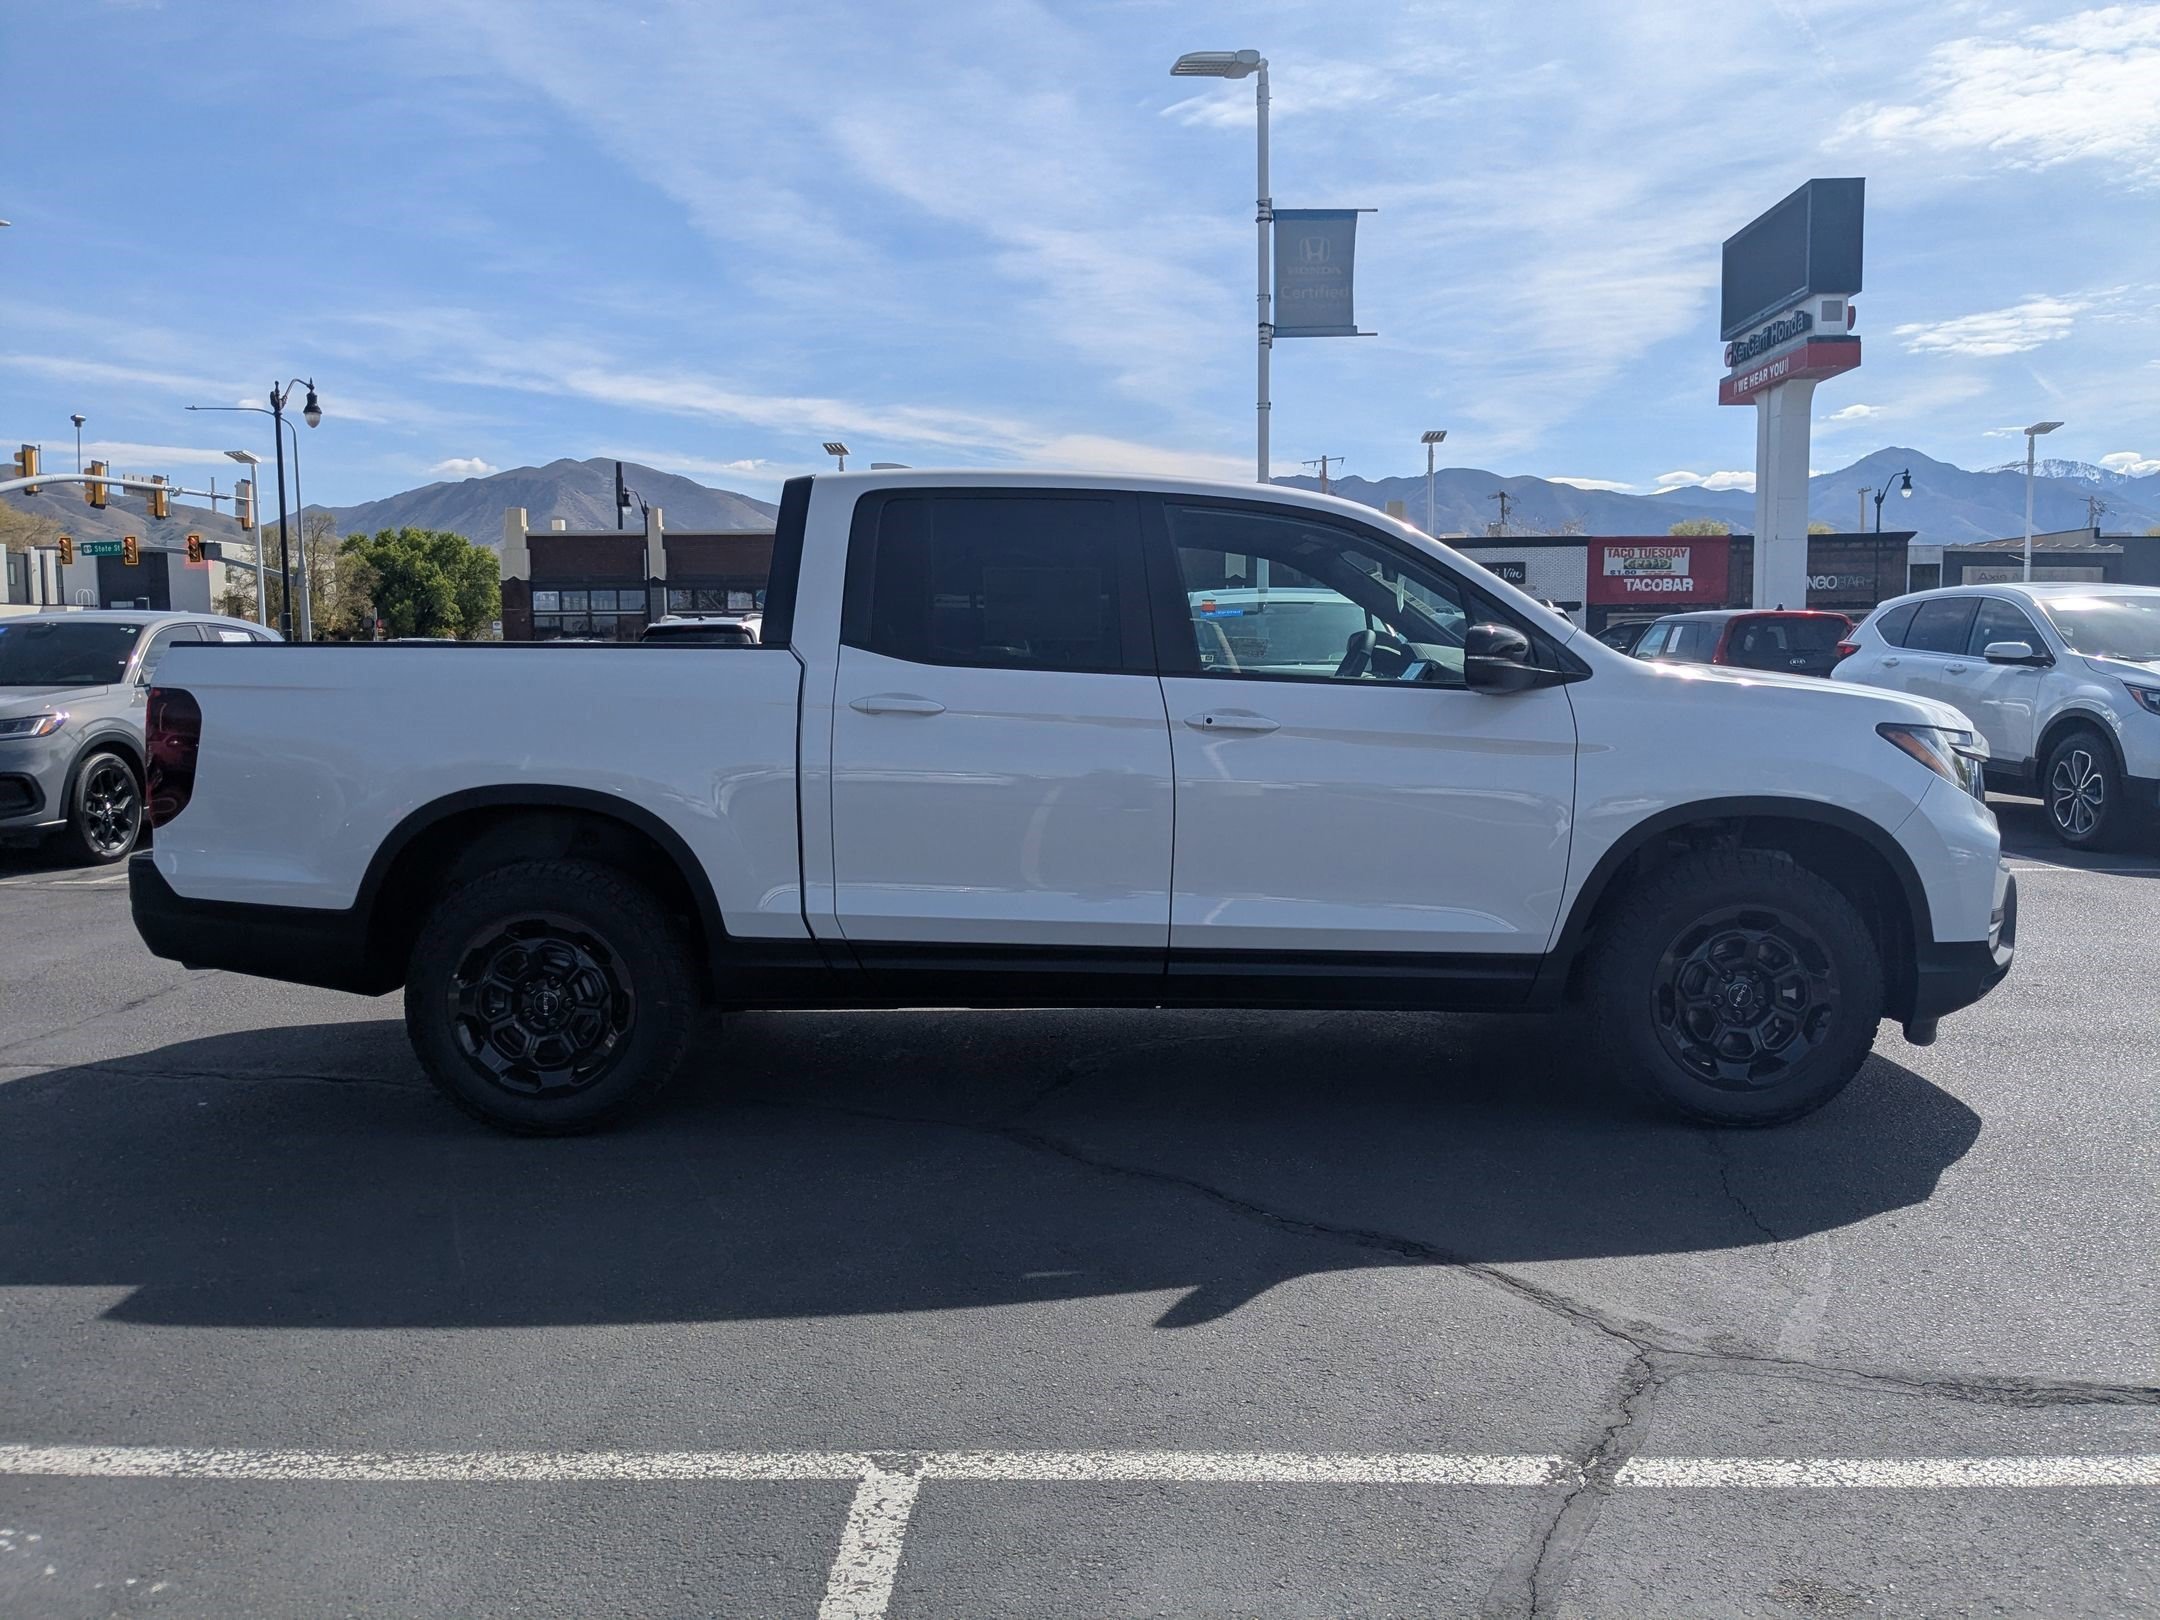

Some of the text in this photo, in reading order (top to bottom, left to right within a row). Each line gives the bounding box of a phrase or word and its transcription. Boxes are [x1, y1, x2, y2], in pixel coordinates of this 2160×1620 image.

[1287, 265, 1343, 275] HONDA
[1281, 283, 1349, 298] Certified
[1738, 359, 1785, 393] WE HEAR YOU
[113, 544, 121, 552] St
[1607, 548, 1688, 558] TACO TUESDAY
[1623, 578, 1694, 592] TACOBAR
